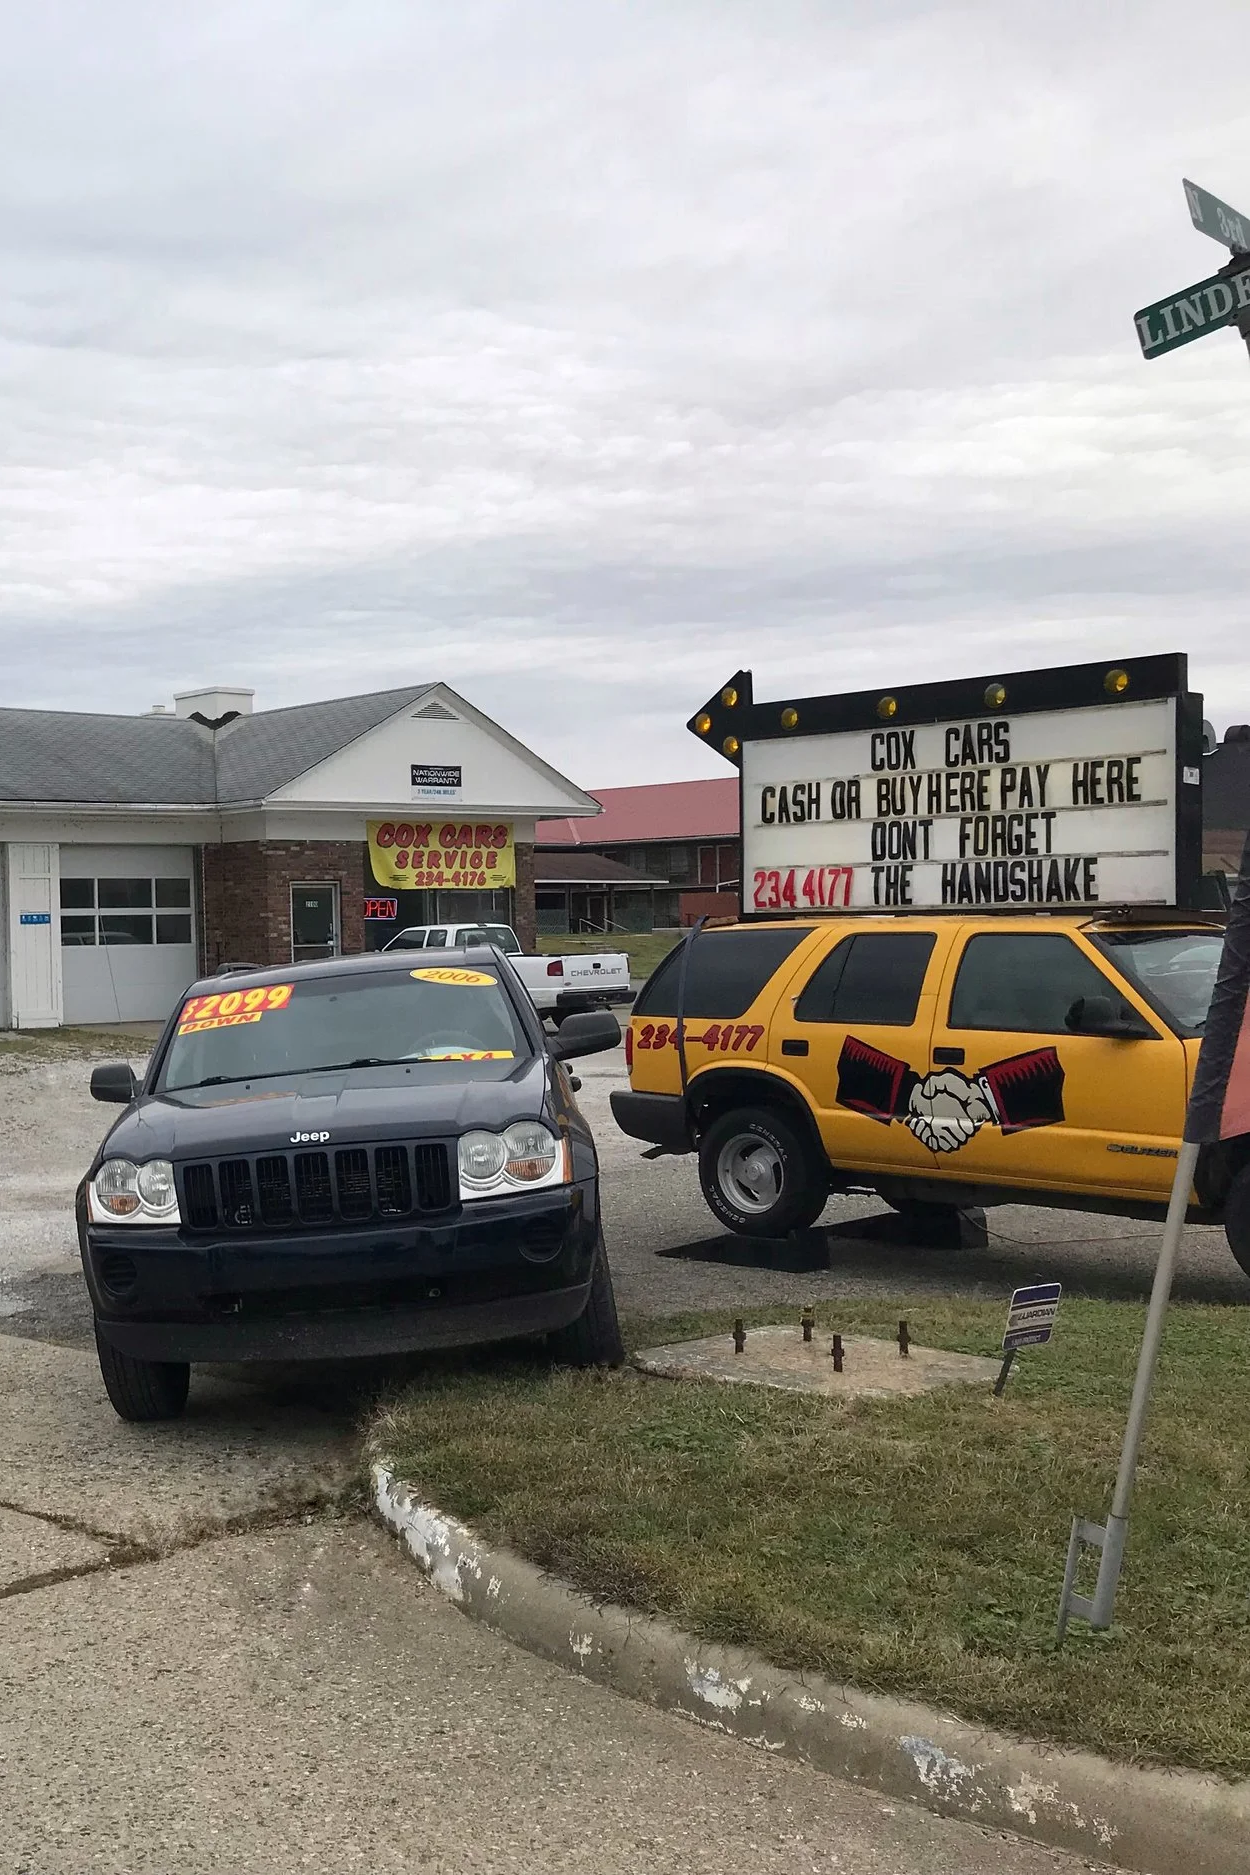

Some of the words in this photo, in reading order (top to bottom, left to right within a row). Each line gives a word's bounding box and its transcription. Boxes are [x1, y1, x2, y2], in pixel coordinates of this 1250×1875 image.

[1185, 186, 1203, 222] N
[871, 730, 915, 771] COX
[945, 721, 1010, 767] CARS
[413, 769, 460, 777] NATIONWIDE
[761, 782, 820, 823] CASH
[831, 780, 861, 819] OR
[1001, 764, 1050, 810] PAY
[1072, 757, 1141, 805] HERE
[376, 823, 432, 848] COX
[439, 824, 507, 849] CARS
[871, 819, 933, 861] DONT
[959, 812, 1056, 858] FORGET
[394, 850, 498, 869] SERVICE
[414, 871, 487, 886] 234-4176
[753, 869, 797, 908] 234
[803, 867, 853, 906] 4177
[871, 865, 913, 905] THE
[942, 858, 1099, 904] HANDSHAKE
[422, 970, 481, 983] 2006
[571, 968, 622, 977] CHEVROLET
[182, 985, 292, 1021] $2099
[182, 1013, 257, 1033] DOWN
[290, 1131, 330, 1143] Jeep
